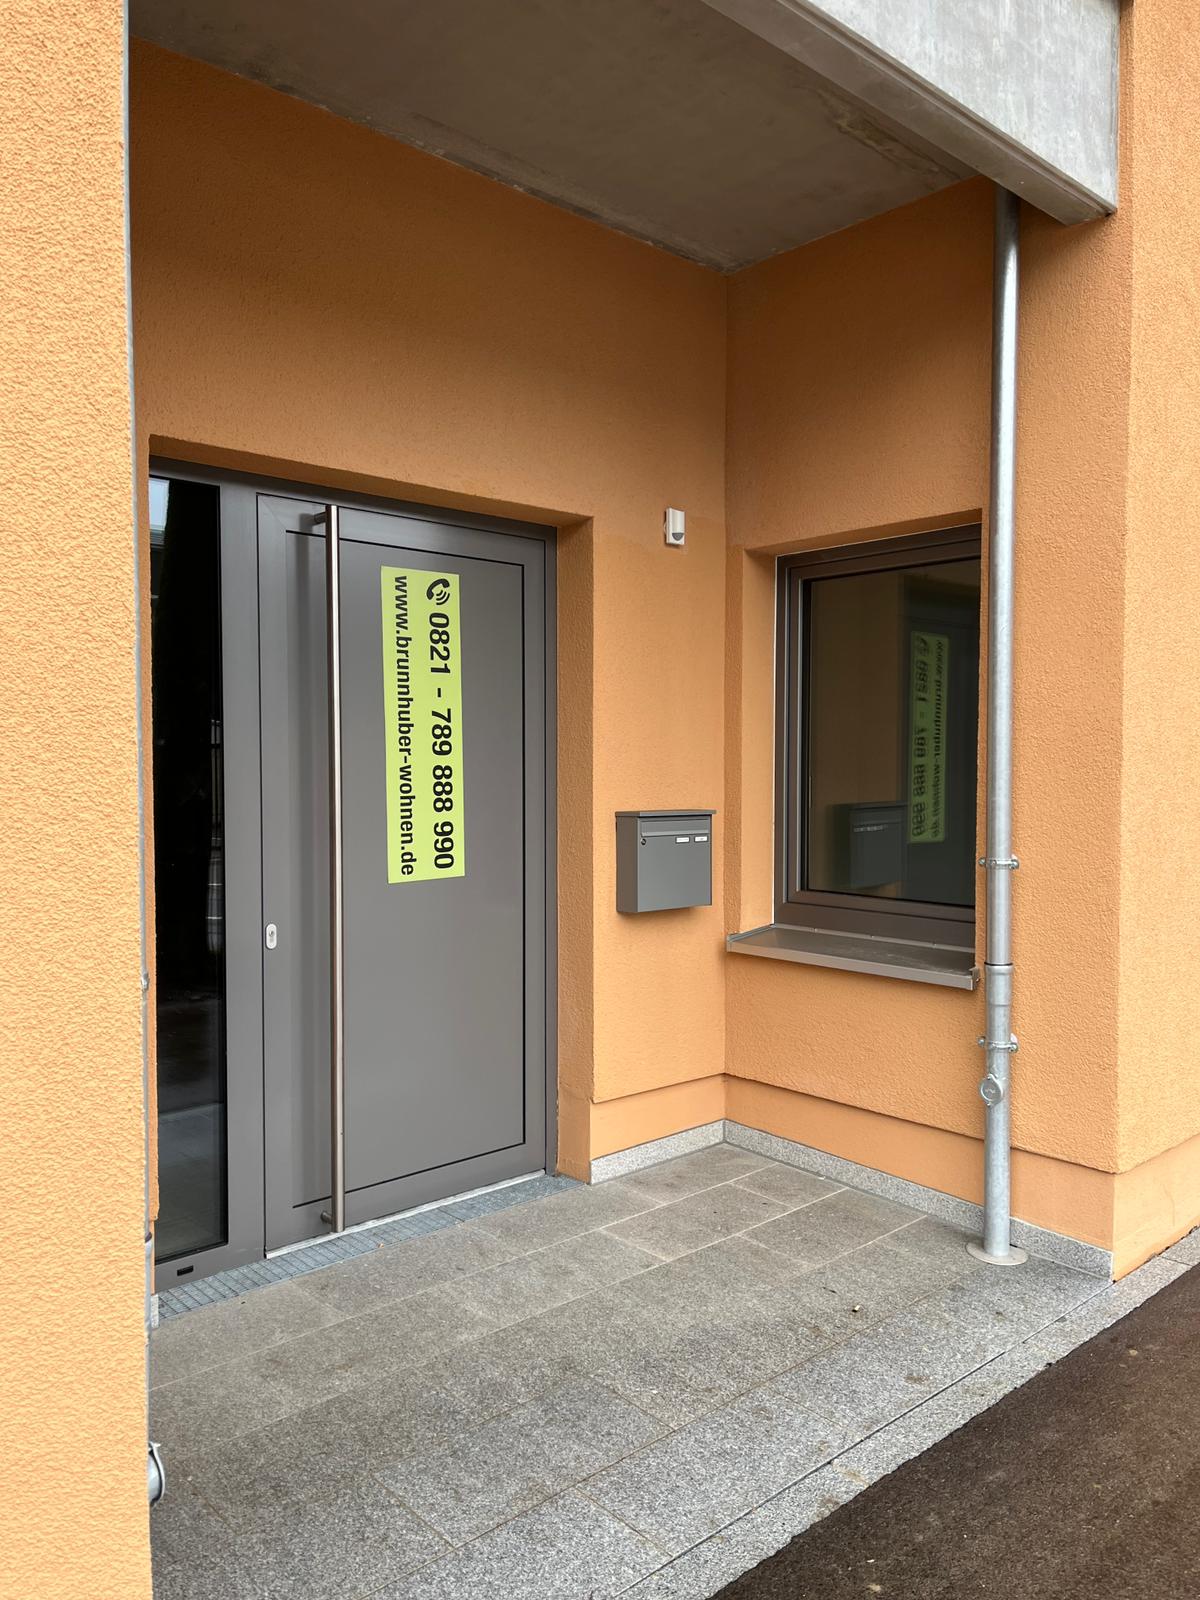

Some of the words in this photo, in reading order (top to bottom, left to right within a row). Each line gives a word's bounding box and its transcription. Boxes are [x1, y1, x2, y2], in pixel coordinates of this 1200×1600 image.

[429, 612, 451, 674] 0821
[394, 575, 417, 876] www.brunnhuber-wohnen.de
[431, 708, 453, 756] 789
[432, 764, 454, 813] 888
[433, 821, 455, 869] 990
